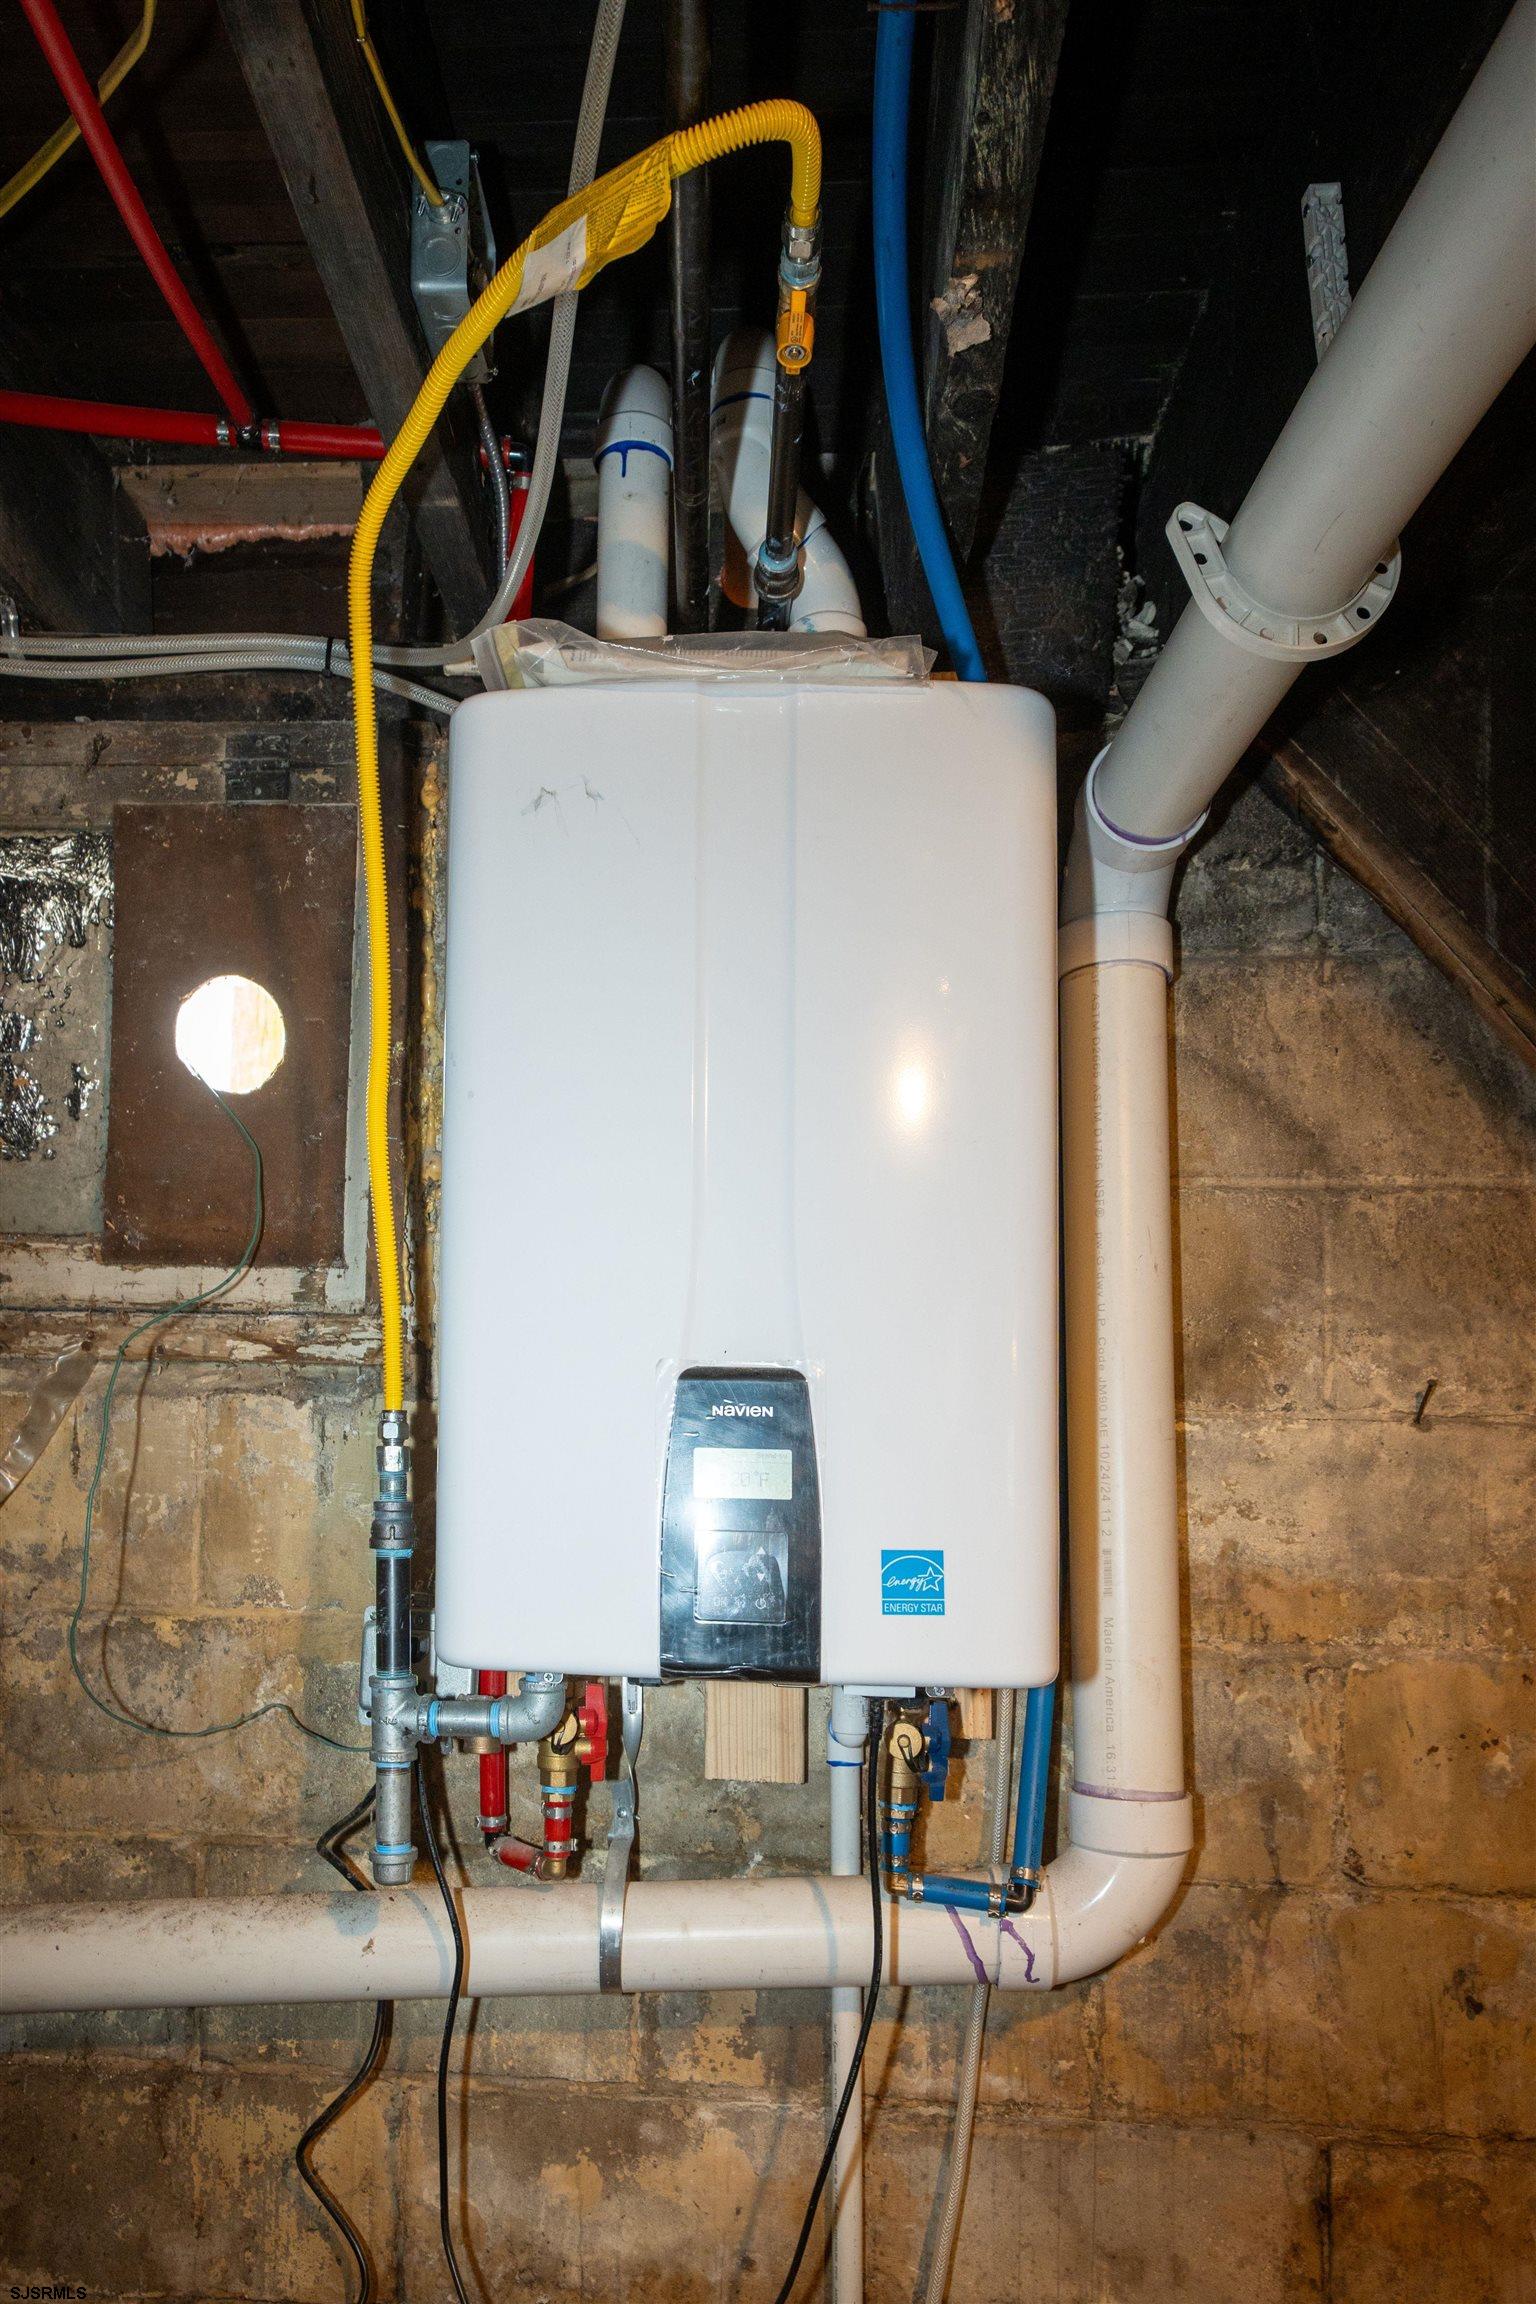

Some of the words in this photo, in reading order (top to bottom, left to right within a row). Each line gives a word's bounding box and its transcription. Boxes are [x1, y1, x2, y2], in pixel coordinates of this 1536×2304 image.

[1092, 1084, 1103, 1122] ASTM
[1093, 1128, 1104, 1170] D1785
[1097, 1336, 1108, 1372] Code
[1097, 1376, 1108, 1412] JM90
[1098, 1417, 1110, 1440] ME
[1099, 1444, 1112, 1502] 10/24/24
[884, 1603, 919, 1613] ENERGY
[920, 1603, 943, 1613] STAR
[1103, 1617, 1116, 1654] Made
[1104, 1659, 1116, 1672] in
